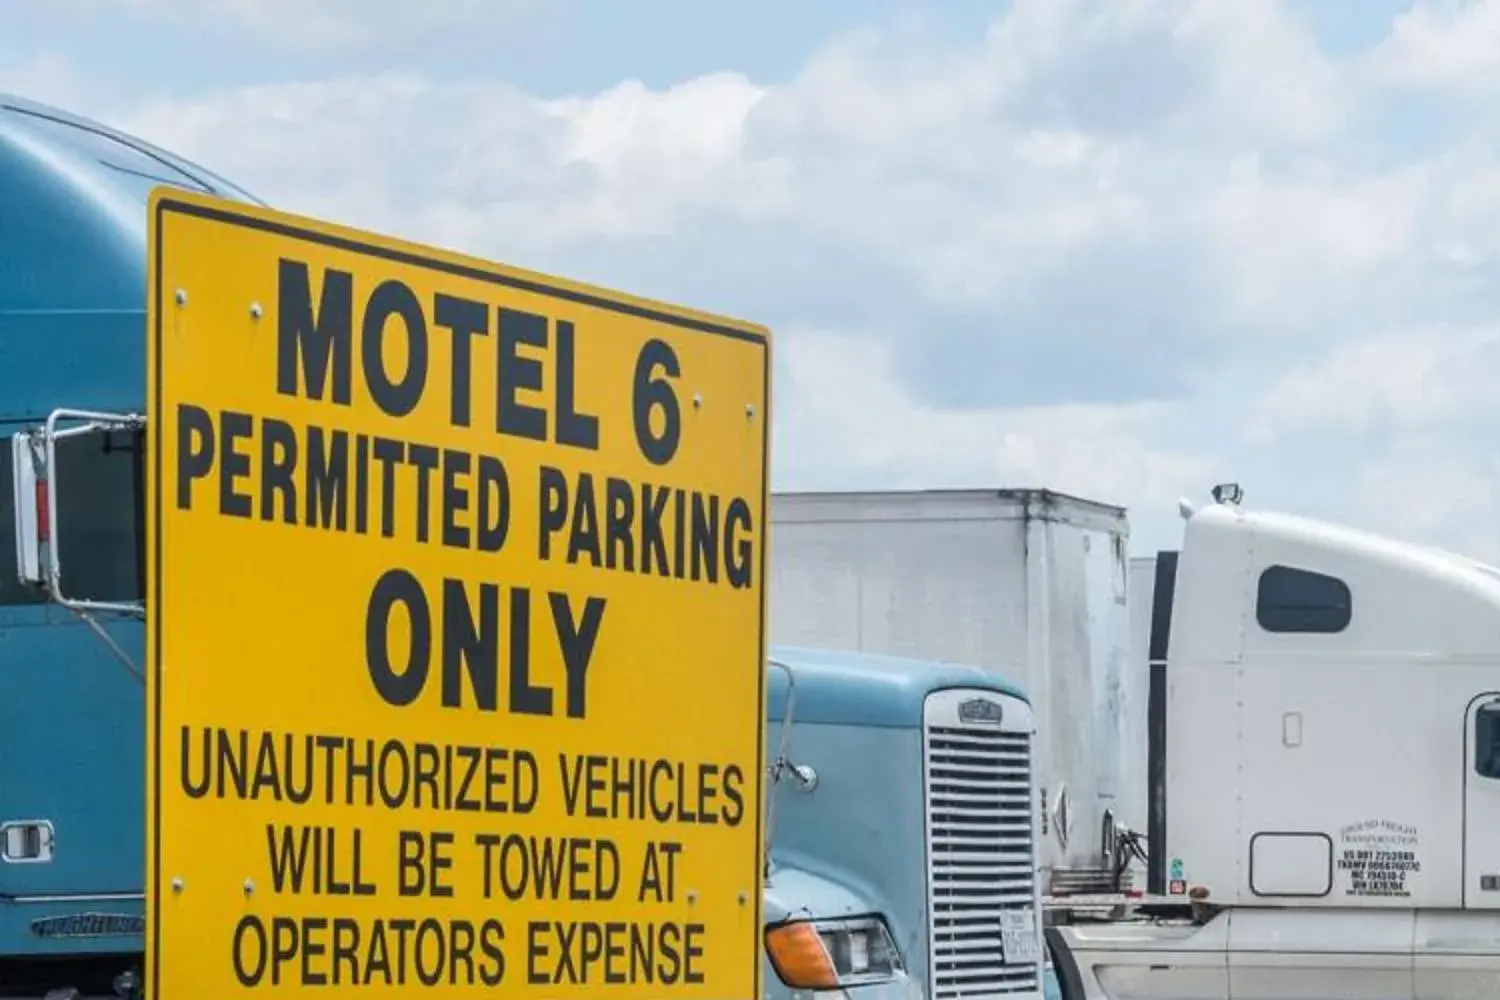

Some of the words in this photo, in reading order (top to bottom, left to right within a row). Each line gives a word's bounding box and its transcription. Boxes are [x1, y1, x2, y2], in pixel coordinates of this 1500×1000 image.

[277, 258, 599, 451] MOTEL
[632, 338, 681, 466] 6
[177, 404, 510, 553] PERMITTED
[539, 465, 754, 589] PARKING
[365, 569, 607, 719] ONLY
[181, 726, 539, 814] UNAUTHORIZED
[559, 753, 744, 827] VEHICLES
[267, 825, 376, 896] WILL
[398, 831, 454, 897] BE
[475, 834, 620, 902] TOWED
[638, 841, 682, 902] AT
[232, 914, 505, 988] OPERATORS
[527, 921, 705, 985] EXPENSE
